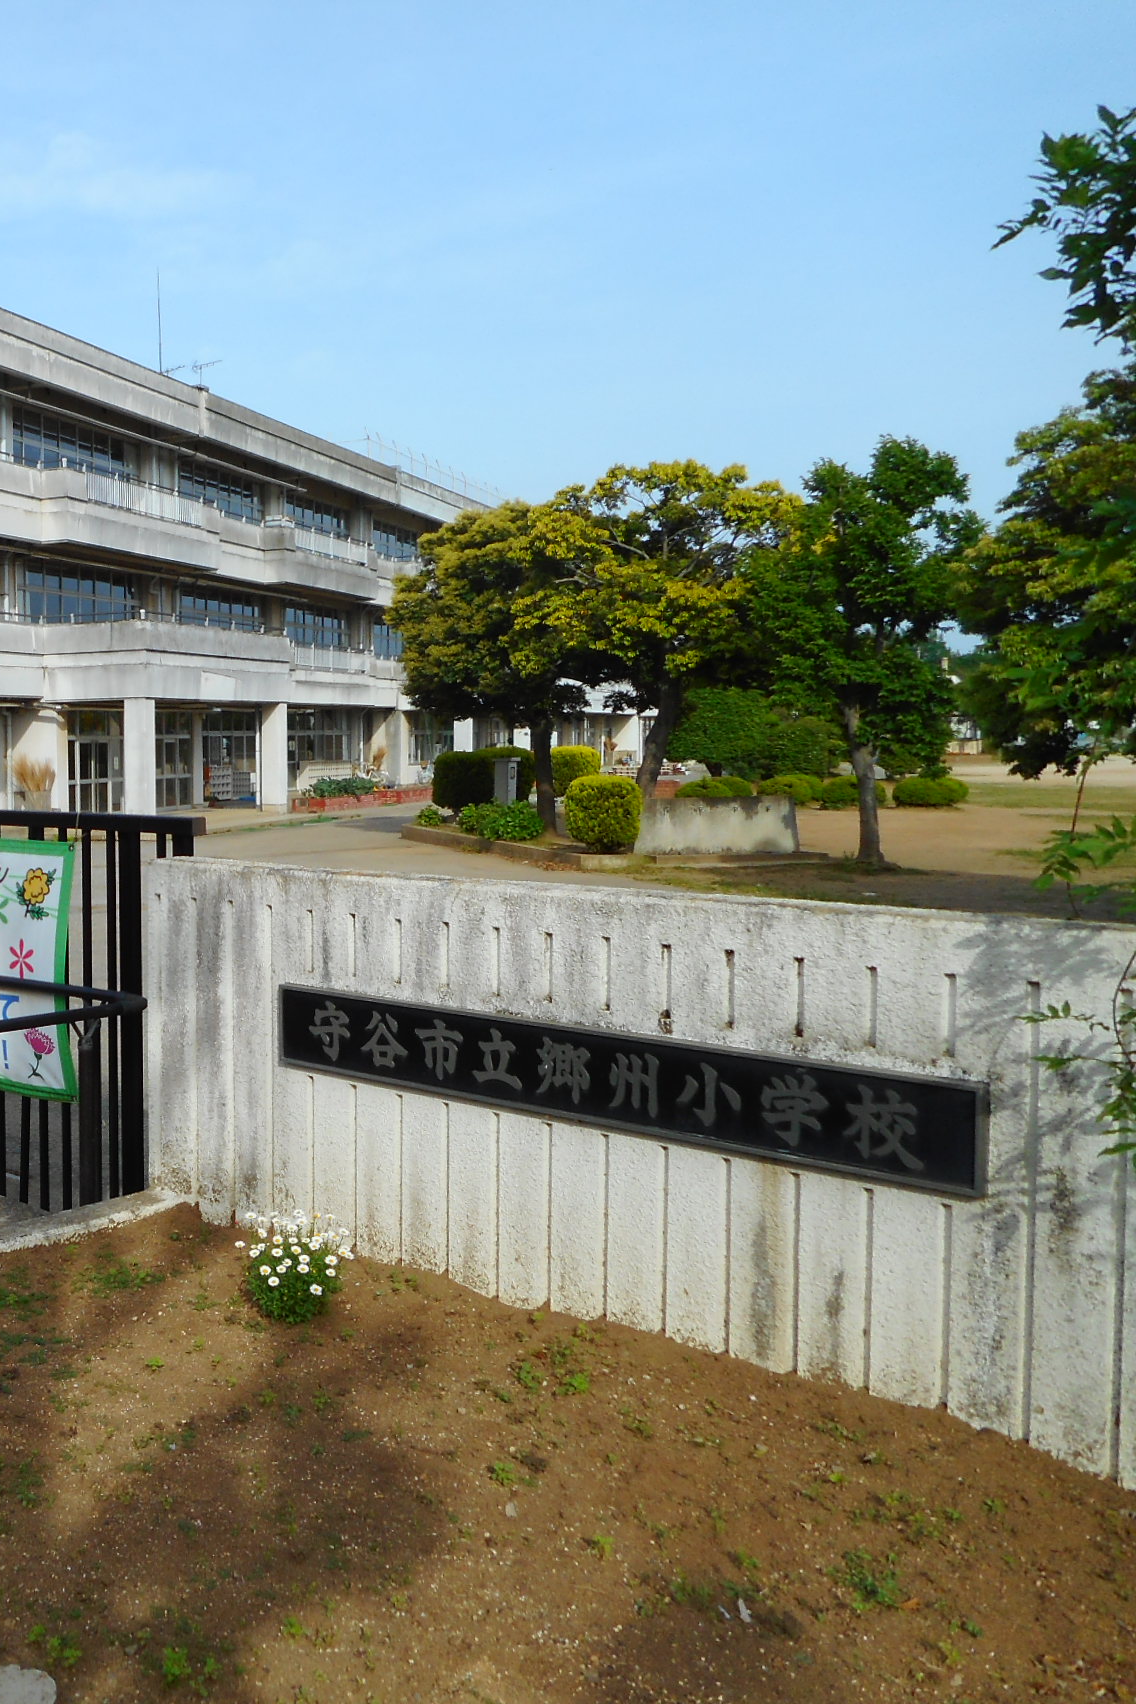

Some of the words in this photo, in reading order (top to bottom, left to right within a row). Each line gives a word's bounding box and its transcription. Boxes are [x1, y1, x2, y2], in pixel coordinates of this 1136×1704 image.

[309, 1000, 925, 1171] 守谷市立郷州小学校
